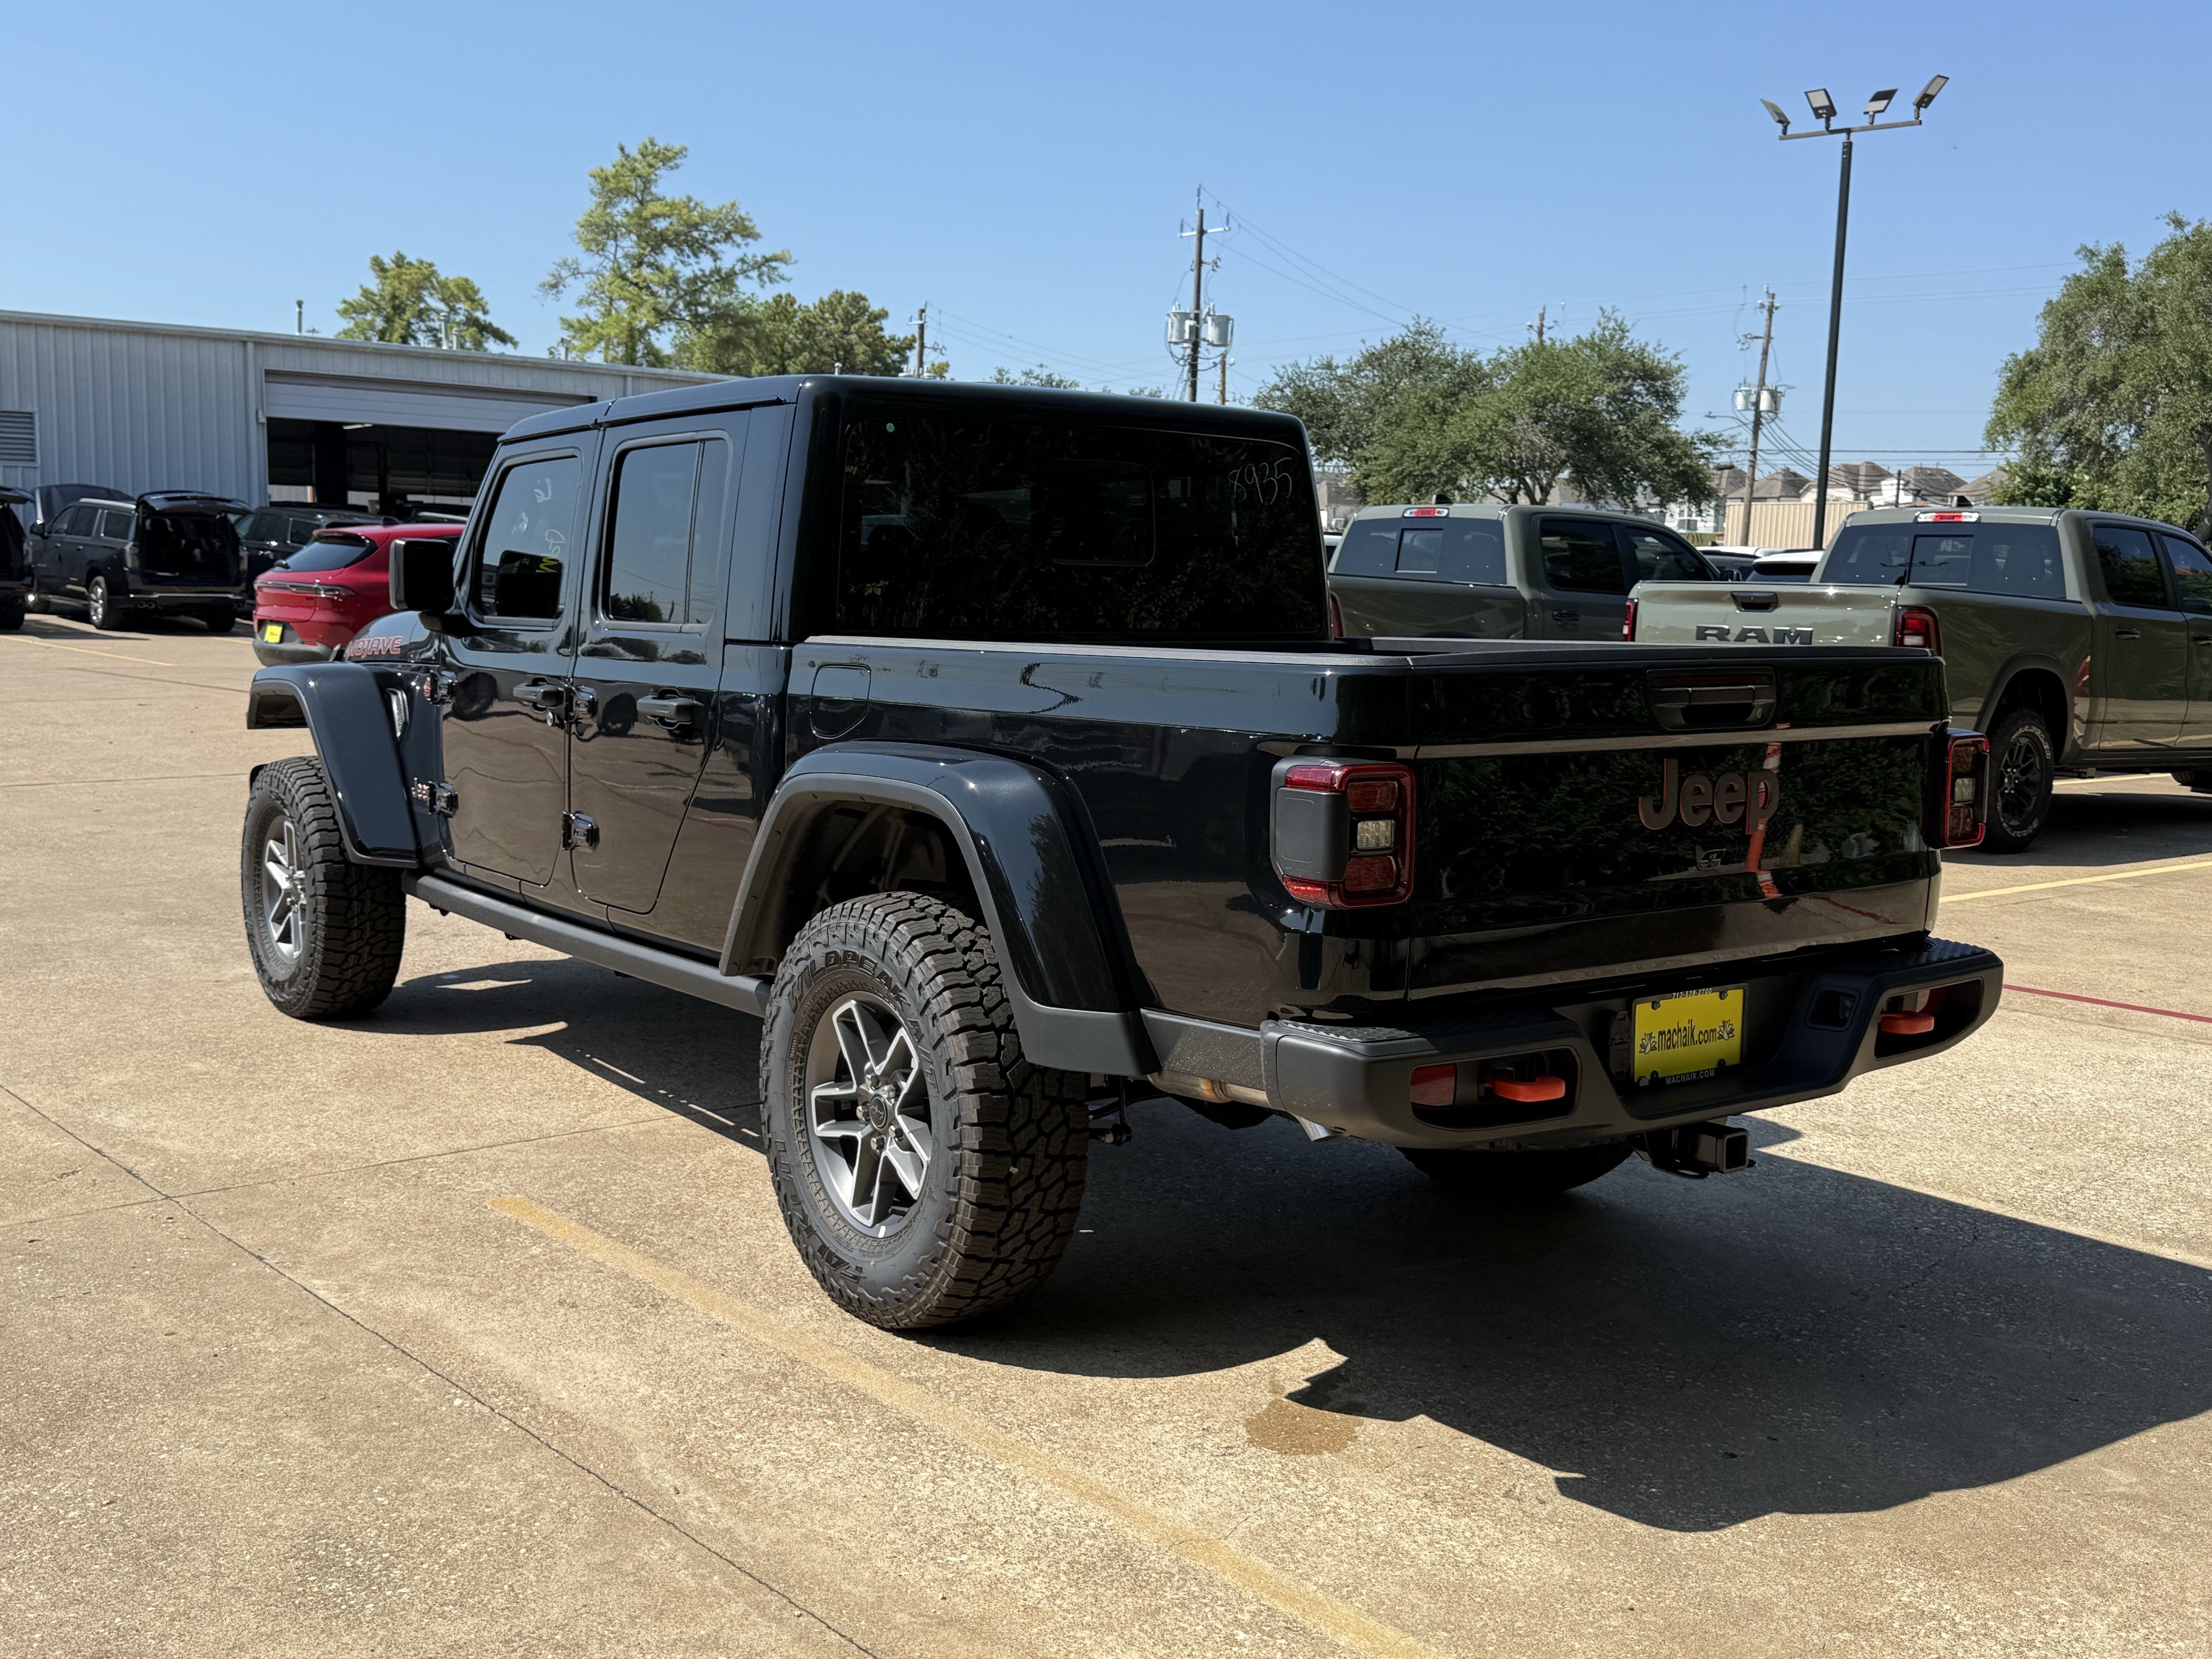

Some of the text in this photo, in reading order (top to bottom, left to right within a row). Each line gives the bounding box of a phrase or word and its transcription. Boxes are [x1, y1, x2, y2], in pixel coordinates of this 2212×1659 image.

[1228, 457, 1292, 503] 8935
[343, 635, 404, 659] MOJAVE
[1695, 624, 1814, 645] RAM
[1638, 758, 1779, 835] Jeep
[788, 948, 911, 1015] WILDPEAK
[1672, 988, 1712, 999] 713-538-2700
[1657, 1018, 1717, 1051] machaik.com
[1666, 1069, 1715, 1085] MACHAIK.COM
[775, 1140, 867, 1284] FALKEN
